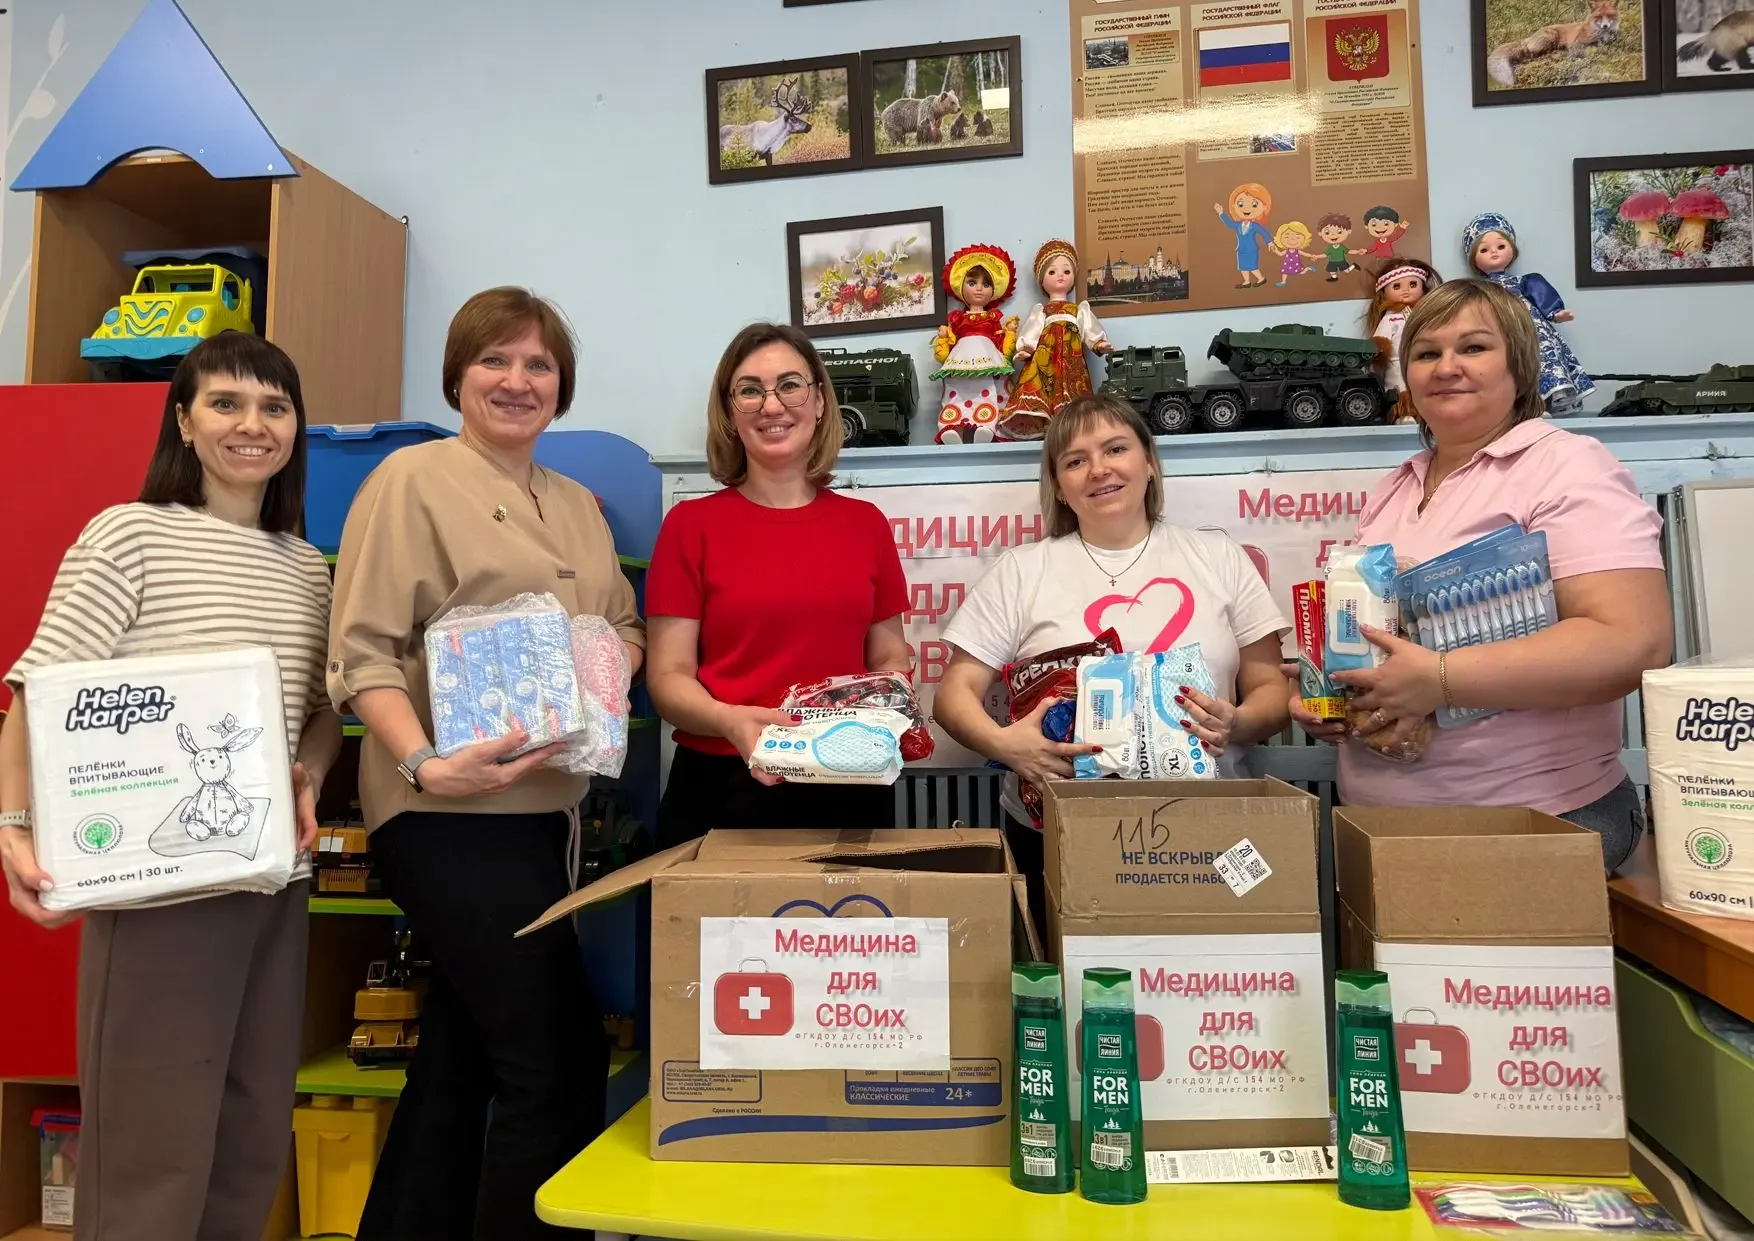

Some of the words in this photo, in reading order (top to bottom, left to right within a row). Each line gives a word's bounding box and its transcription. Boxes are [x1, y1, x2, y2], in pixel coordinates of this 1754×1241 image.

[823, 357, 899, 366] ЕОПАСНО!
[1695, 390, 1727, 398] АРМИЯ
[1238, 488, 1367, 522] Медиц
[888, 514, 1042, 557] дицин
[1423, 565, 1461, 582] ocean
[903, 582, 966, 625] дл
[1299, 588, 1316, 655] Промис
[1011, 655, 1082, 694] КРЕПК
[1184, 662, 1193, 673] 60
[76, 683, 166, 711] Helen
[803, 711, 857, 721] ОТЕНЦА
[1687, 698, 1754, 721] Hele
[65, 701, 175, 735] Harper
[1676, 717, 1754, 751] Harp
[69, 760, 126, 775] ПЕЛЁНКИ
[1169, 754, 1180, 771] XL
[69, 766, 165, 785] ВПИТЫВАЮЩИЕ
[1677, 775, 1735, 786] ПЕЛЁНКИ
[70, 784, 118, 798] Зелёная
[120, 777, 179, 791] коллекция
[1681, 798, 1727, 810] Зелёная
[1123, 852, 1143, 865] НЕ
[1148, 851, 1222, 866] ВСКРЫВА
[1238, 845, 1253, 858] 20
[120, 873, 136, 882] см
[146, 866, 162, 877] 30
[164, 865, 183, 875] шт.
[1218, 864, 1229, 875] 33
[1115, 873, 1189, 886] ПРОДАЕТСЯ
[1192, 873, 1226, 885] НАБО
[1730, 896, 1746, 906] см
[775, 929, 917, 958] Медицина
[827, 971, 877, 995] для
[1139, 968, 1295, 997] Медицина
[1444, 978, 1612, 1010] Медицина
[816, 1003, 906, 1028] СВОих
[1200, 1011, 1253, 1035] для
[795, 1032, 838, 1041] ФГКДОУ
[867, 1033, 884, 1041] 154
[889, 1033, 904, 1041] МО
[909, 1033, 923, 1041] РФ
[1025, 1029, 1045, 1037] ЧИСТАЯ
[1099, 1036, 1120, 1044] ЧИСТАЯ
[1509, 1026, 1568, 1050] для
[1355, 1038, 1377, 1046] ЧИСТАЯ
[1188, 1045, 1286, 1071] СВОих
[1020, 1067, 1053, 1083] FOR
[1166, 1076, 1212, 1085] ФГКДОУ
[1245, 1075, 1264, 1084] 154
[1269, 1076, 1285, 1084] МО
[1291, 1076, 1306, 1084] РФ
[1497, 1060, 1603, 1087] СВОих
[1020, 1081, 1054, 1097] MEN
[1093, 1076, 1128, 1091] FOR
[1350, 1077, 1387, 1094] FOR
[850, 1093, 910, 1101] КЛАССИЧЕСКИЕ
[1094, 1090, 1129, 1105] MEN
[1350, 1092, 1388, 1108] MEN
[1473, 1092, 1523, 1101] ФГКДОУ
[1559, 1093, 1578, 1102] 154
[1585, 1094, 1601, 1102] МО
